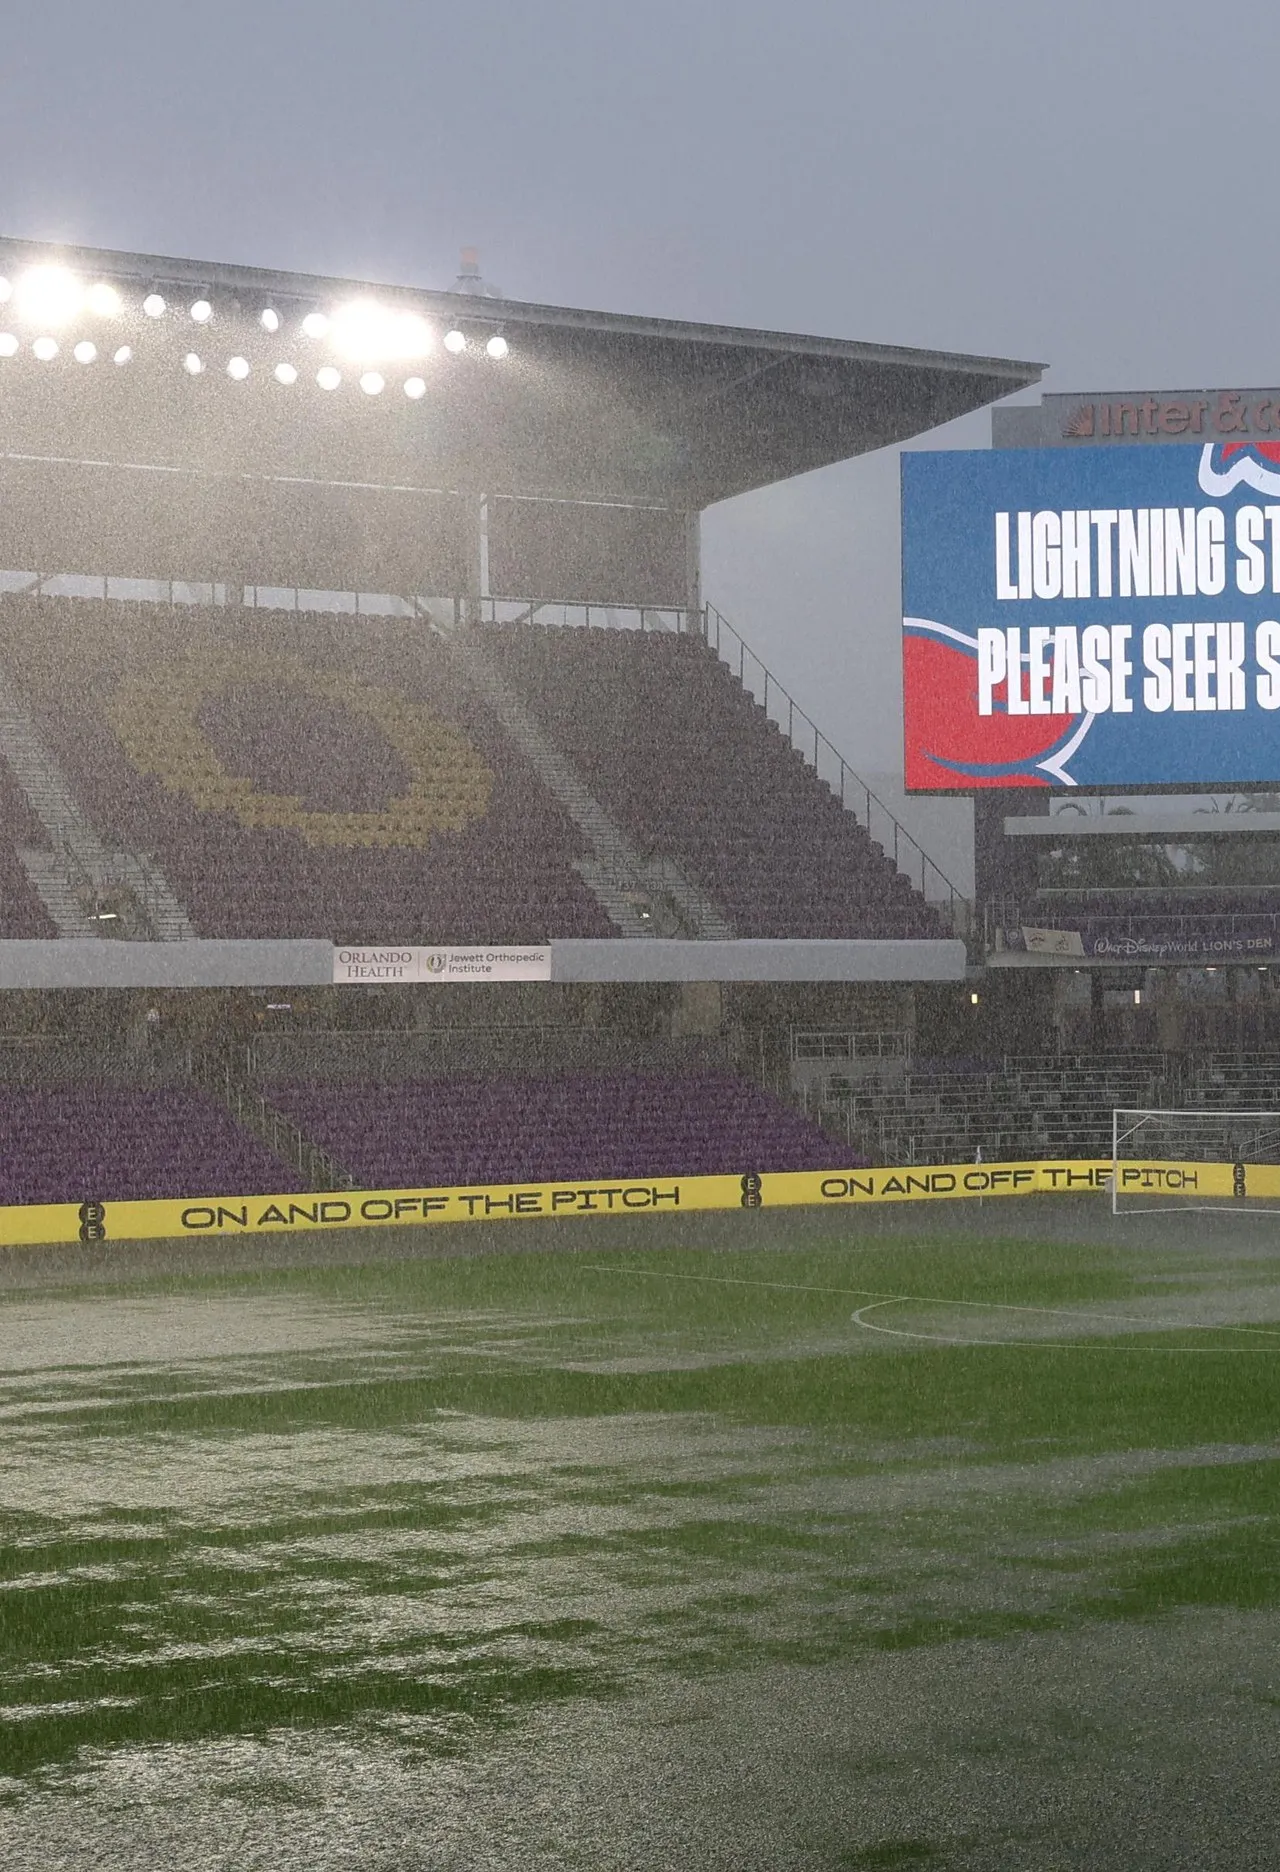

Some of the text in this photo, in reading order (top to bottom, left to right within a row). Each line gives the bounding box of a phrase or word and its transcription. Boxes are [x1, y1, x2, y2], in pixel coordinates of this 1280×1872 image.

[995, 506, 1225, 600] LIGHTNING
[977, 624, 1133, 716] PLEASE
[1142, 621, 1247, 712] SEEK
[1167, 939, 1198, 953] World
[1202, 940, 1243, 952] LION'S
[1246, 937, 1272, 949] DEN
[339, 950, 413, 964] ORLANDO
[449, 952, 545, 963] Jewett Orthopedic
[347, 965, 404, 978] HEALTH
[449, 964, 492, 973] Institute
[821, 1169, 1197, 1197] ON AND OFF THE PITCH
[182, 1187, 680, 1228] ON AND OFF THE PITCH
